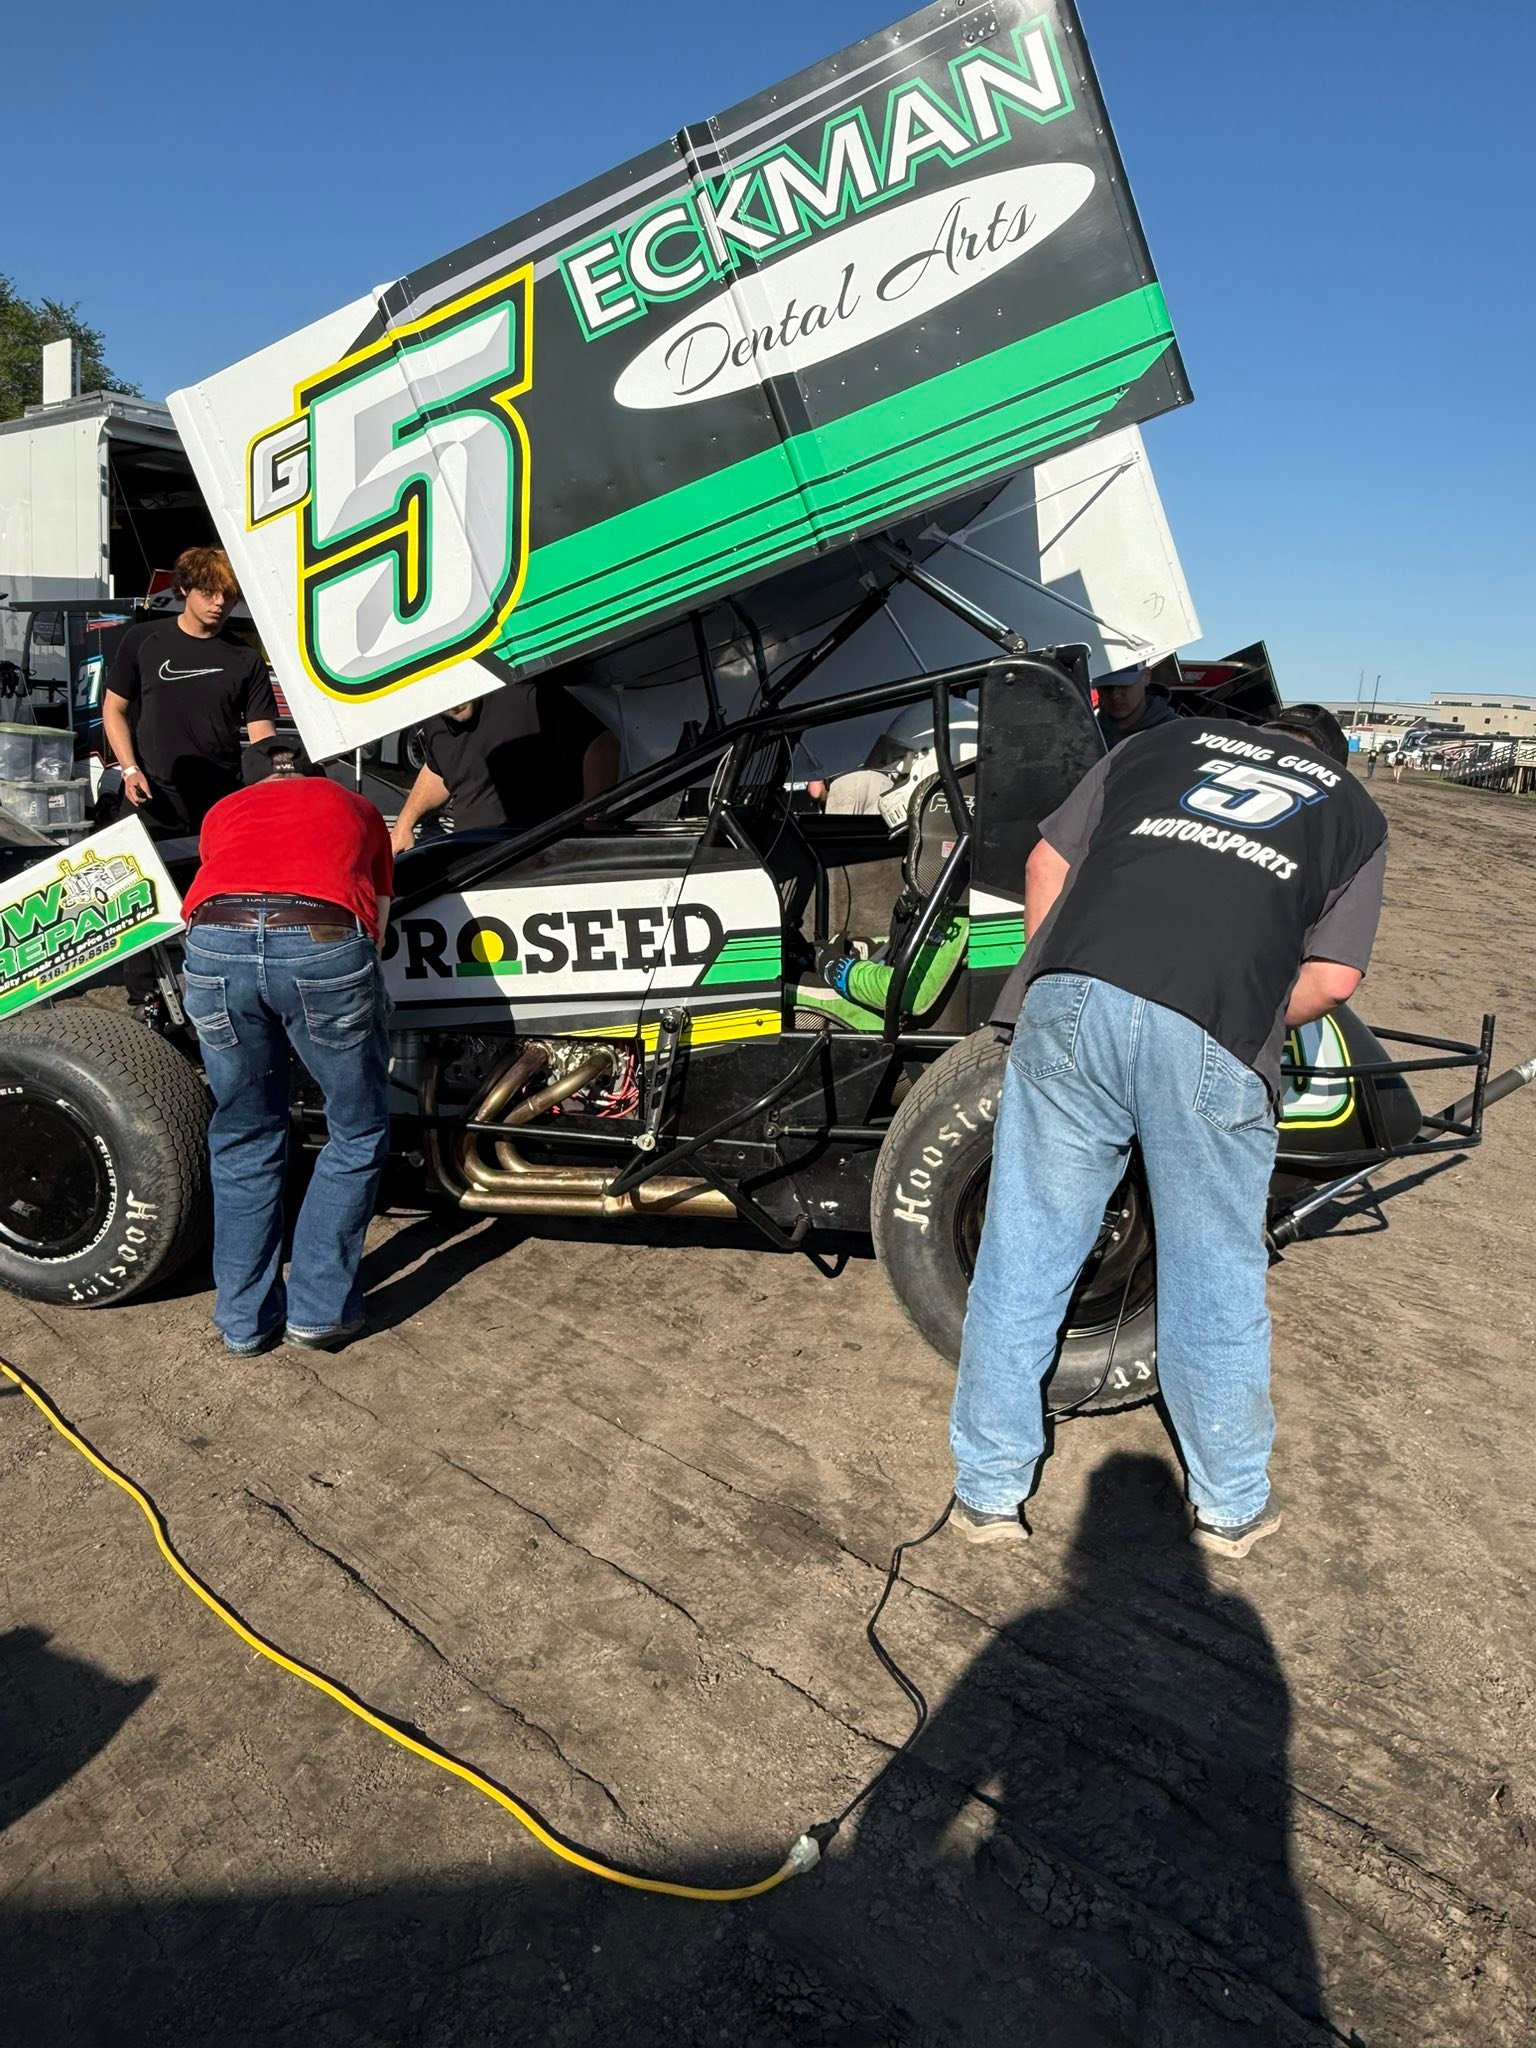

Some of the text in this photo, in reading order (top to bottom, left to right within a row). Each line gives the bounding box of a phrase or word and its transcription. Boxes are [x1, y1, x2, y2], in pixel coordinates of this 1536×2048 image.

[562, 17, 1073, 337] ECKMAN
[664, 195, 1037, 396] Dental Arts
[1191, 732, 1341, 788] YOUNG GUNS
[1130, 817, 1299, 880] MOTORSPORTS
[0, 884, 63, 949] W
[0, 880, 153, 979] REPAIR
[22, 960, 52, 981] repair
[54, 951, 66, 964] at
[76, 934, 103, 956] price
[104, 918, 134, 937] that's
[136, 906, 155, 922] fair
[40, 939, 117, 984] 218.779.8589
[893, 1083, 1002, 1234] Hoosie
